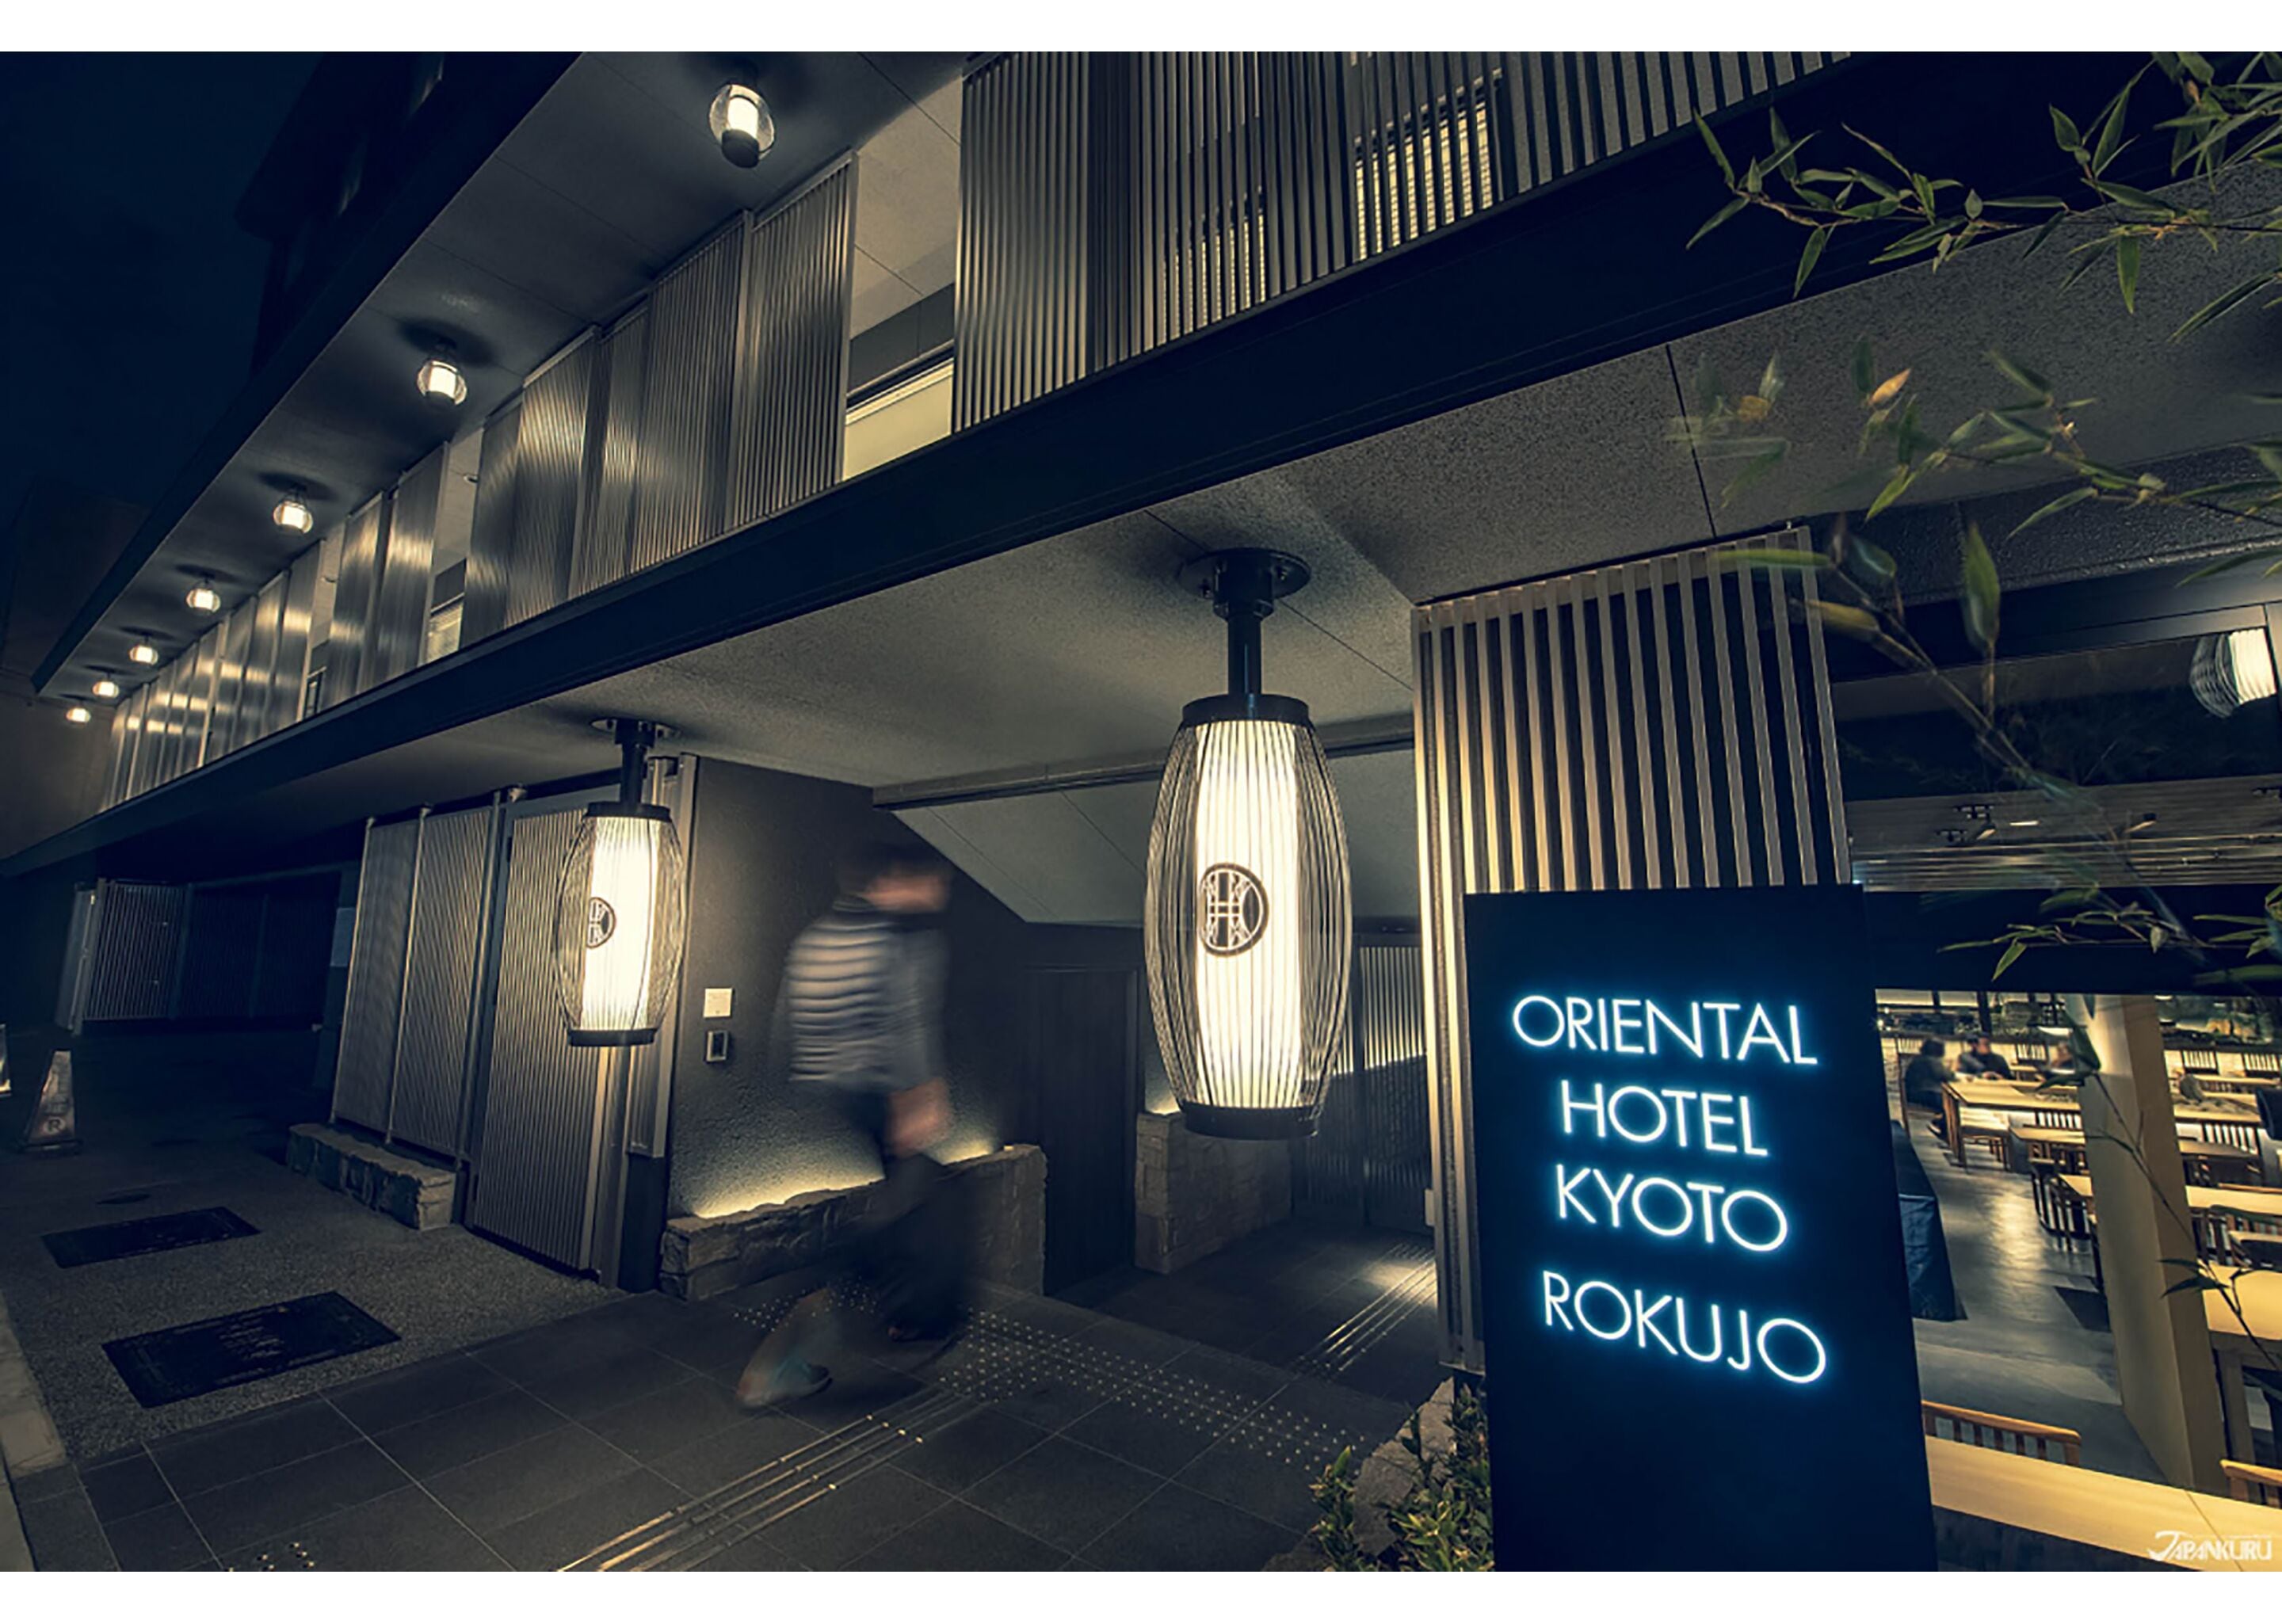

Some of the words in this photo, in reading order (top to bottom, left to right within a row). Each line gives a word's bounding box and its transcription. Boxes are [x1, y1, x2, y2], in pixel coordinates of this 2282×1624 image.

[1512, 994, 1818, 1066] ORIENTAL
[1561, 1079, 1769, 1157] HOTEL
[1556, 1163, 1788, 1252] KYOTO
[1542, 1270, 1827, 1384] ROKUJO
